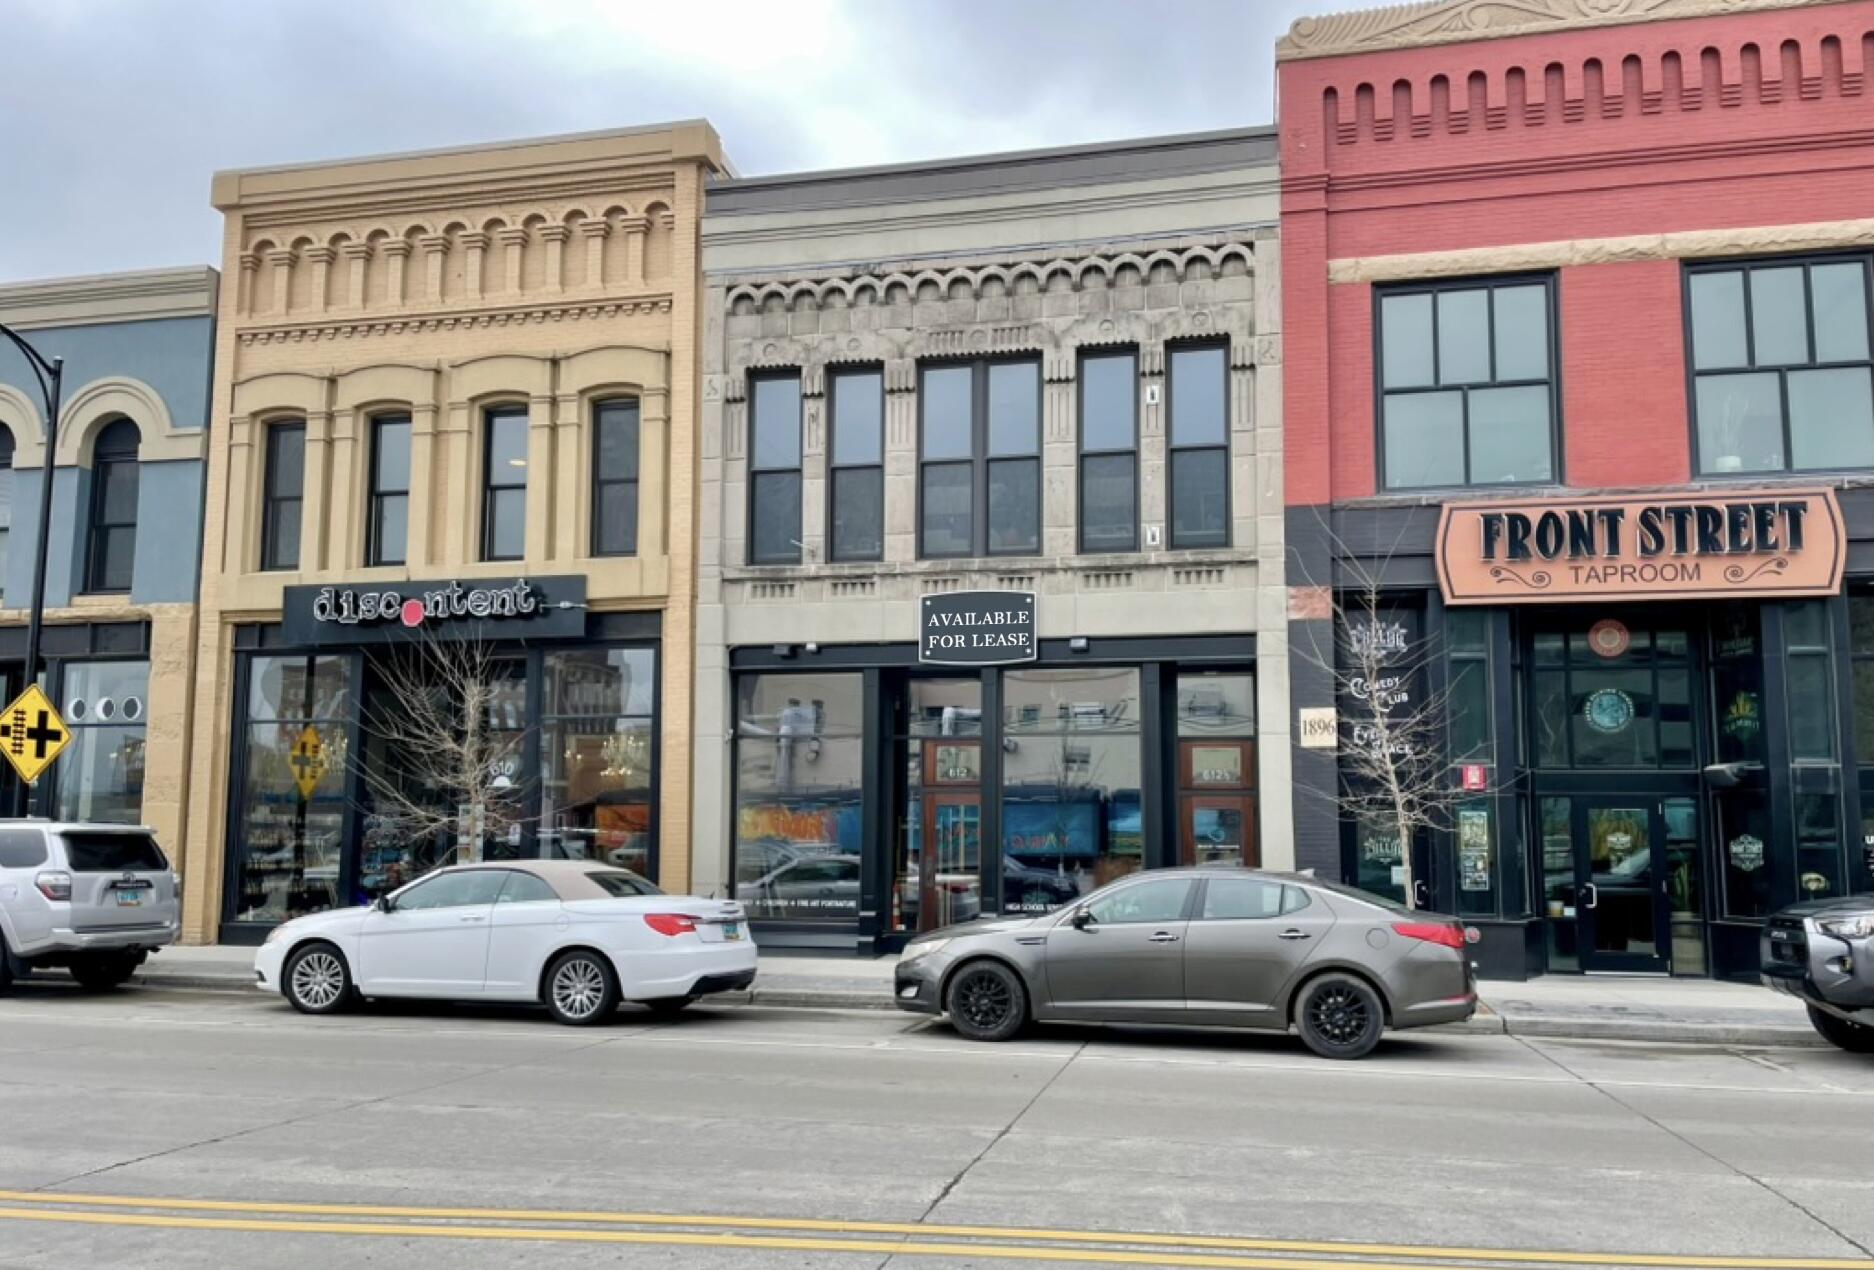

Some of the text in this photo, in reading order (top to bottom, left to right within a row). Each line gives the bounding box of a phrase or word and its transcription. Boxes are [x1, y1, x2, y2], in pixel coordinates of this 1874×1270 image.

[1479, 501, 1808, 561] FRONT STREET
[1569, 563, 1701, 585] TAPROOM
[928, 611, 1030, 627] AVAILABLE
[928, 632, 1030, 649] FOR LEASE
[1302, 718, 1335, 737] 1896
[490, 758, 515, 776] 610
